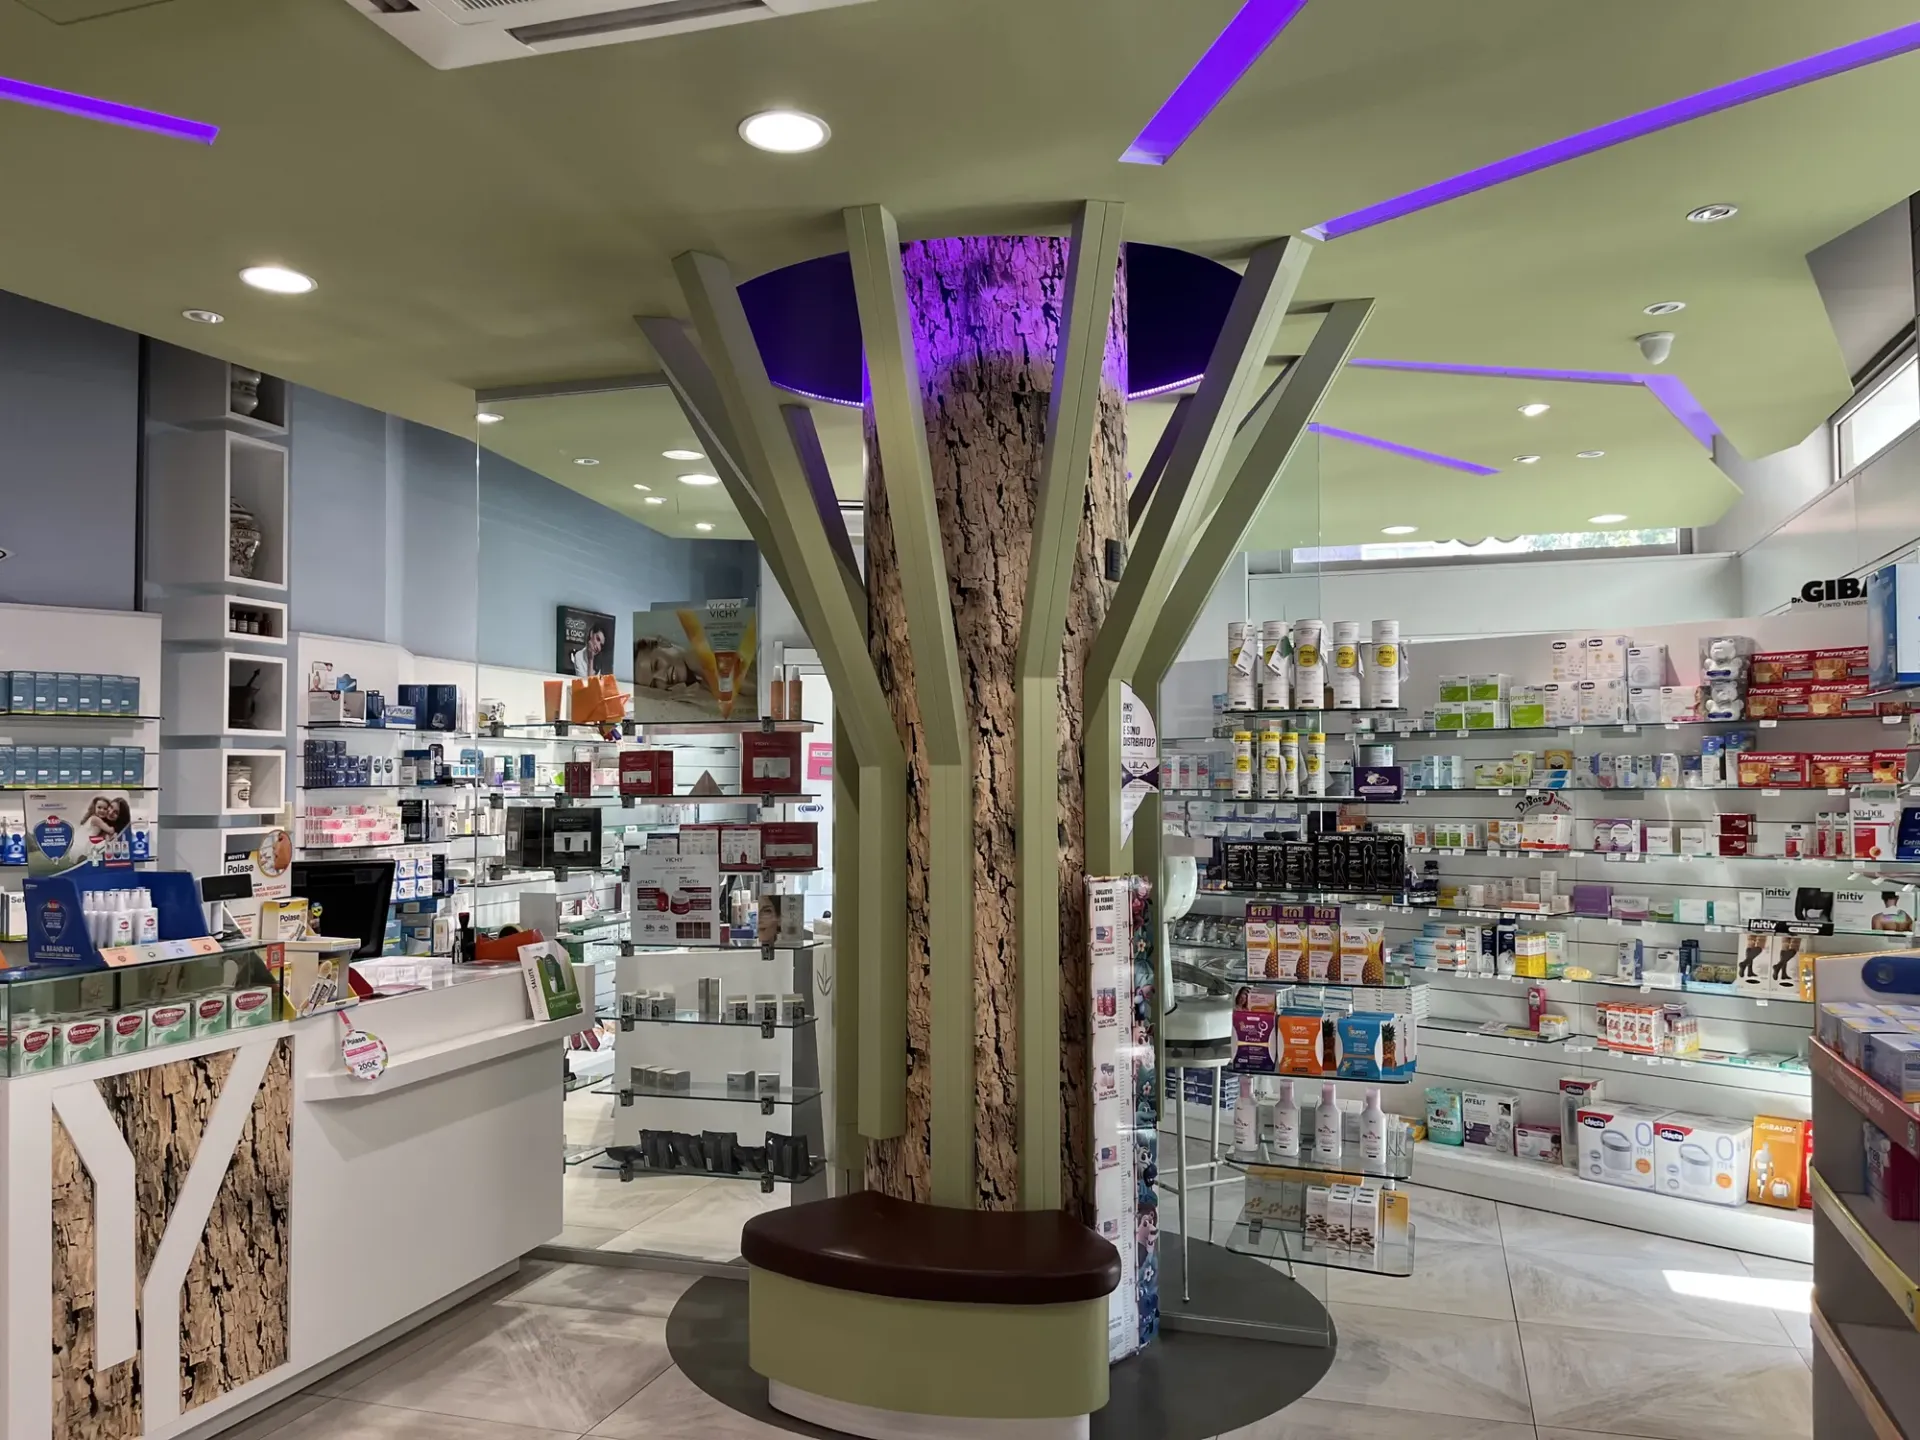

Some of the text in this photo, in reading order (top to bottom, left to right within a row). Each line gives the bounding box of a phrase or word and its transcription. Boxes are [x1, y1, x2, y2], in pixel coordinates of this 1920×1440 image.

[709, 609, 738, 618] VICHY
[1754, 653, 1809, 661] ThermaCare
[1815, 649, 1868, 657] ThermaCar
[1748, 686, 1803, 694] ThermaCare
[228, 864, 254, 874] Polase
[1765, 888, 1791, 897] initiv
[1837, 892, 1864, 901] initiv
[280, 914, 300, 922] Polase
[1750, 920, 1777, 929] initiv
[238, 993, 268, 1004] Venoruton
[154, 1009, 185, 1020] Venoruton
[118, 1016, 143, 1027] Venoruton
[69, 1025, 100, 1036] Venoruton
[358, 1060, 378, 1070] 200€
[1566, 1086, 1584, 1094] chicco
[1464, 1098, 1486, 1106] AVENT
[1430, 1116, 1453, 1126] Pampers
[1585, 1117, 1605, 1127] chicco
[1760, 1122, 1792, 1133] GIBAUD
[1661, 1130, 1684, 1141] chicco
